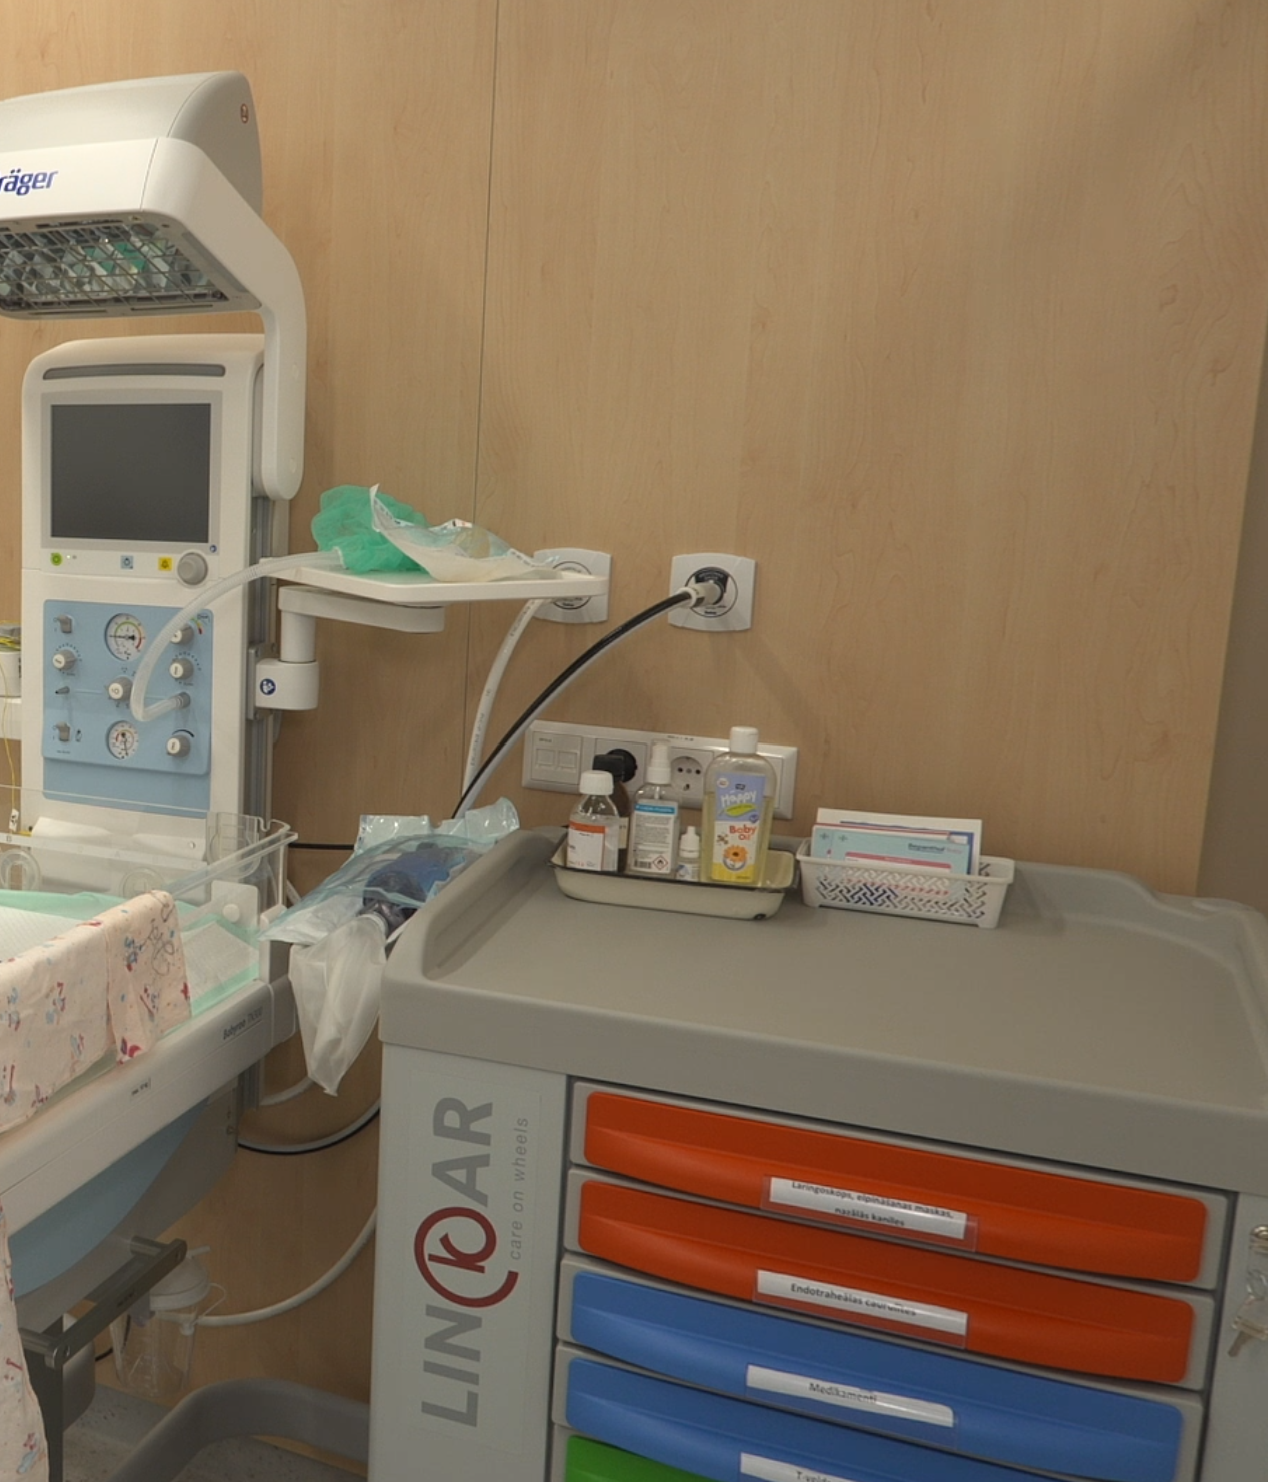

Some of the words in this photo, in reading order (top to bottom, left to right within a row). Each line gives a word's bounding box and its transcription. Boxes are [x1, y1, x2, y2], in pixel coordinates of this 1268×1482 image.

[728, 824, 757, 836] Baby
[511, 1116, 529, 1182] wheels
[512, 1189, 524, 1207] on
[792, 1181, 854, 1201] Laringoskops,
[510, 1219, 523, 1261] care
[808, 1382, 878, 1403] Medikamenti
